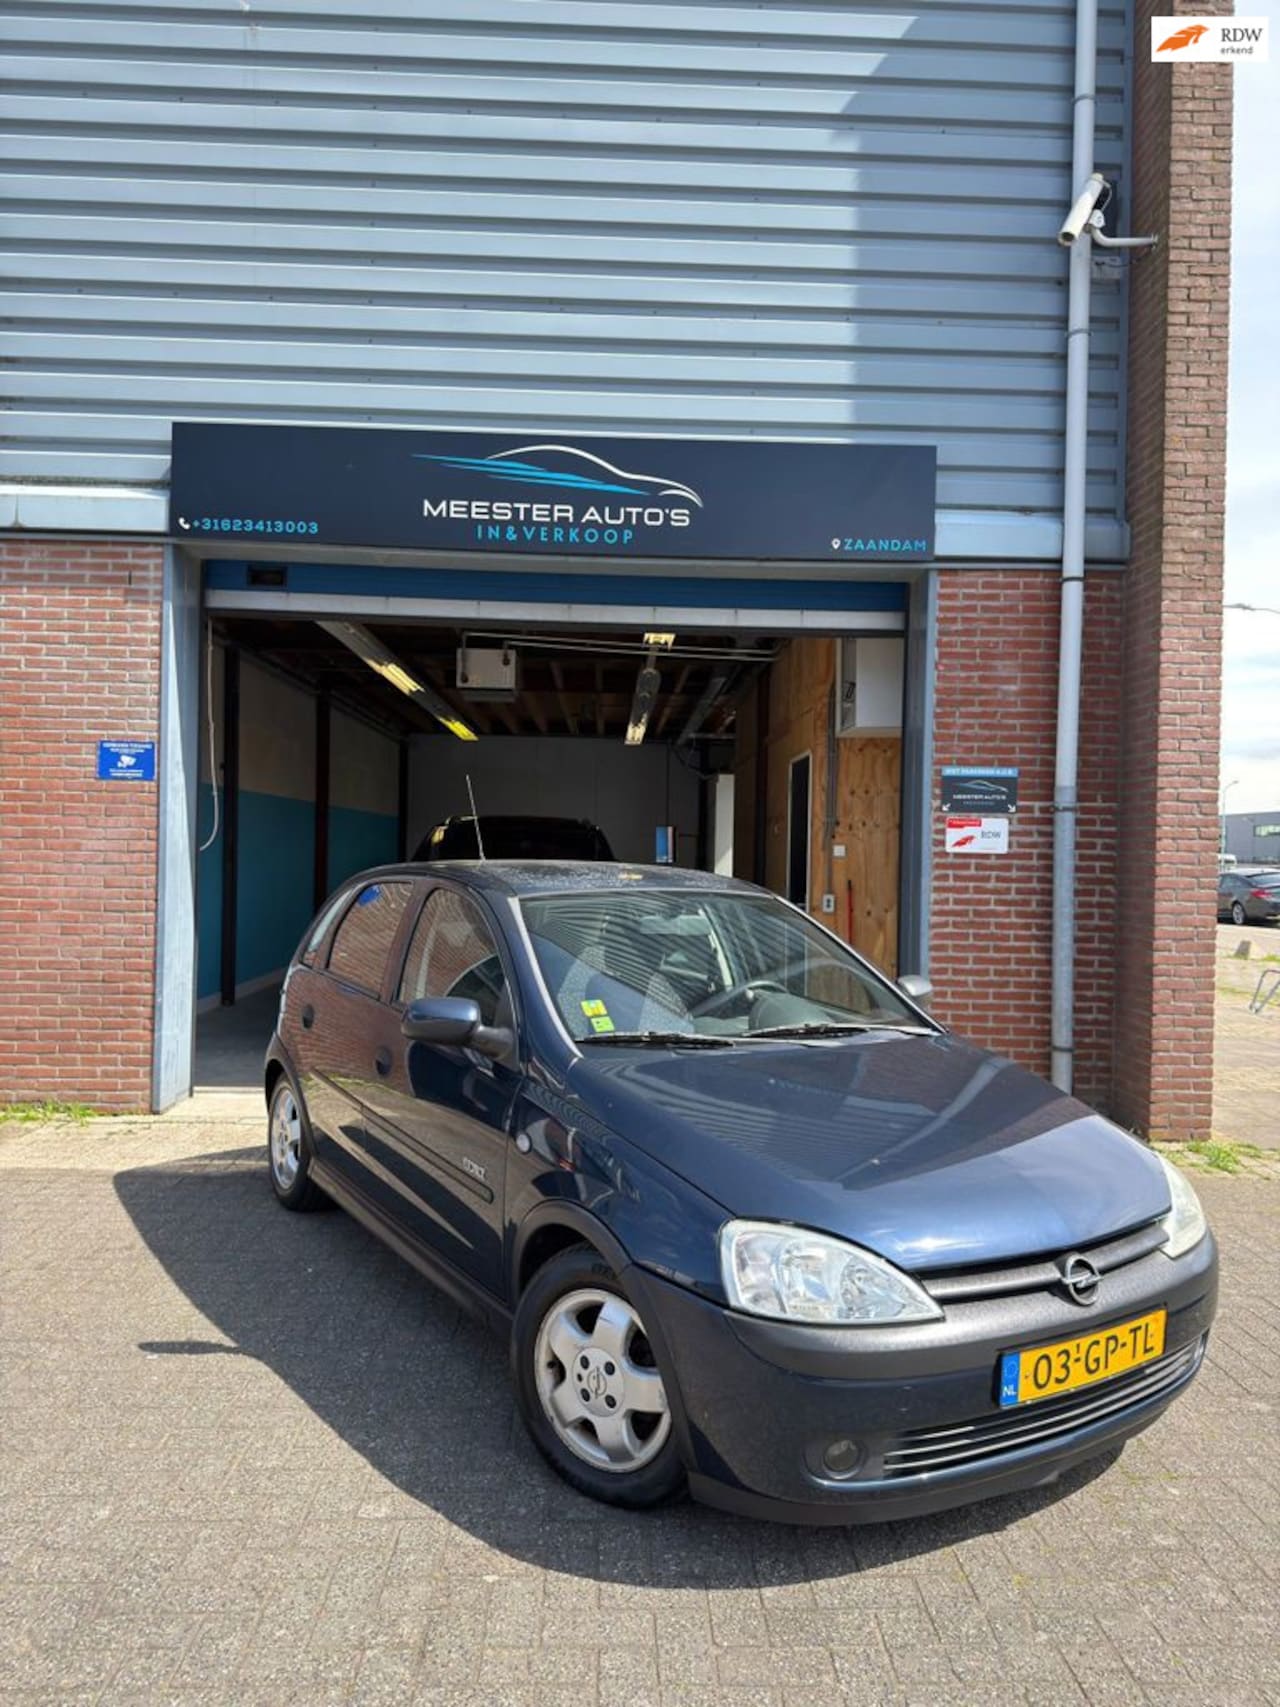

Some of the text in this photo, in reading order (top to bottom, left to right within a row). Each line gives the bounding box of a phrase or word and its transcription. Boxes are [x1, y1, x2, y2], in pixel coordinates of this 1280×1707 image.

[423, 499, 690, 527] MEESTER AUTO'S
[192, 517, 319, 534] +31623413003
[475, 524, 633, 544] IN&VERKOOP
[843, 538, 927, 551] ZAANDAM
[1002, 1385, 1017, 1397] NL
